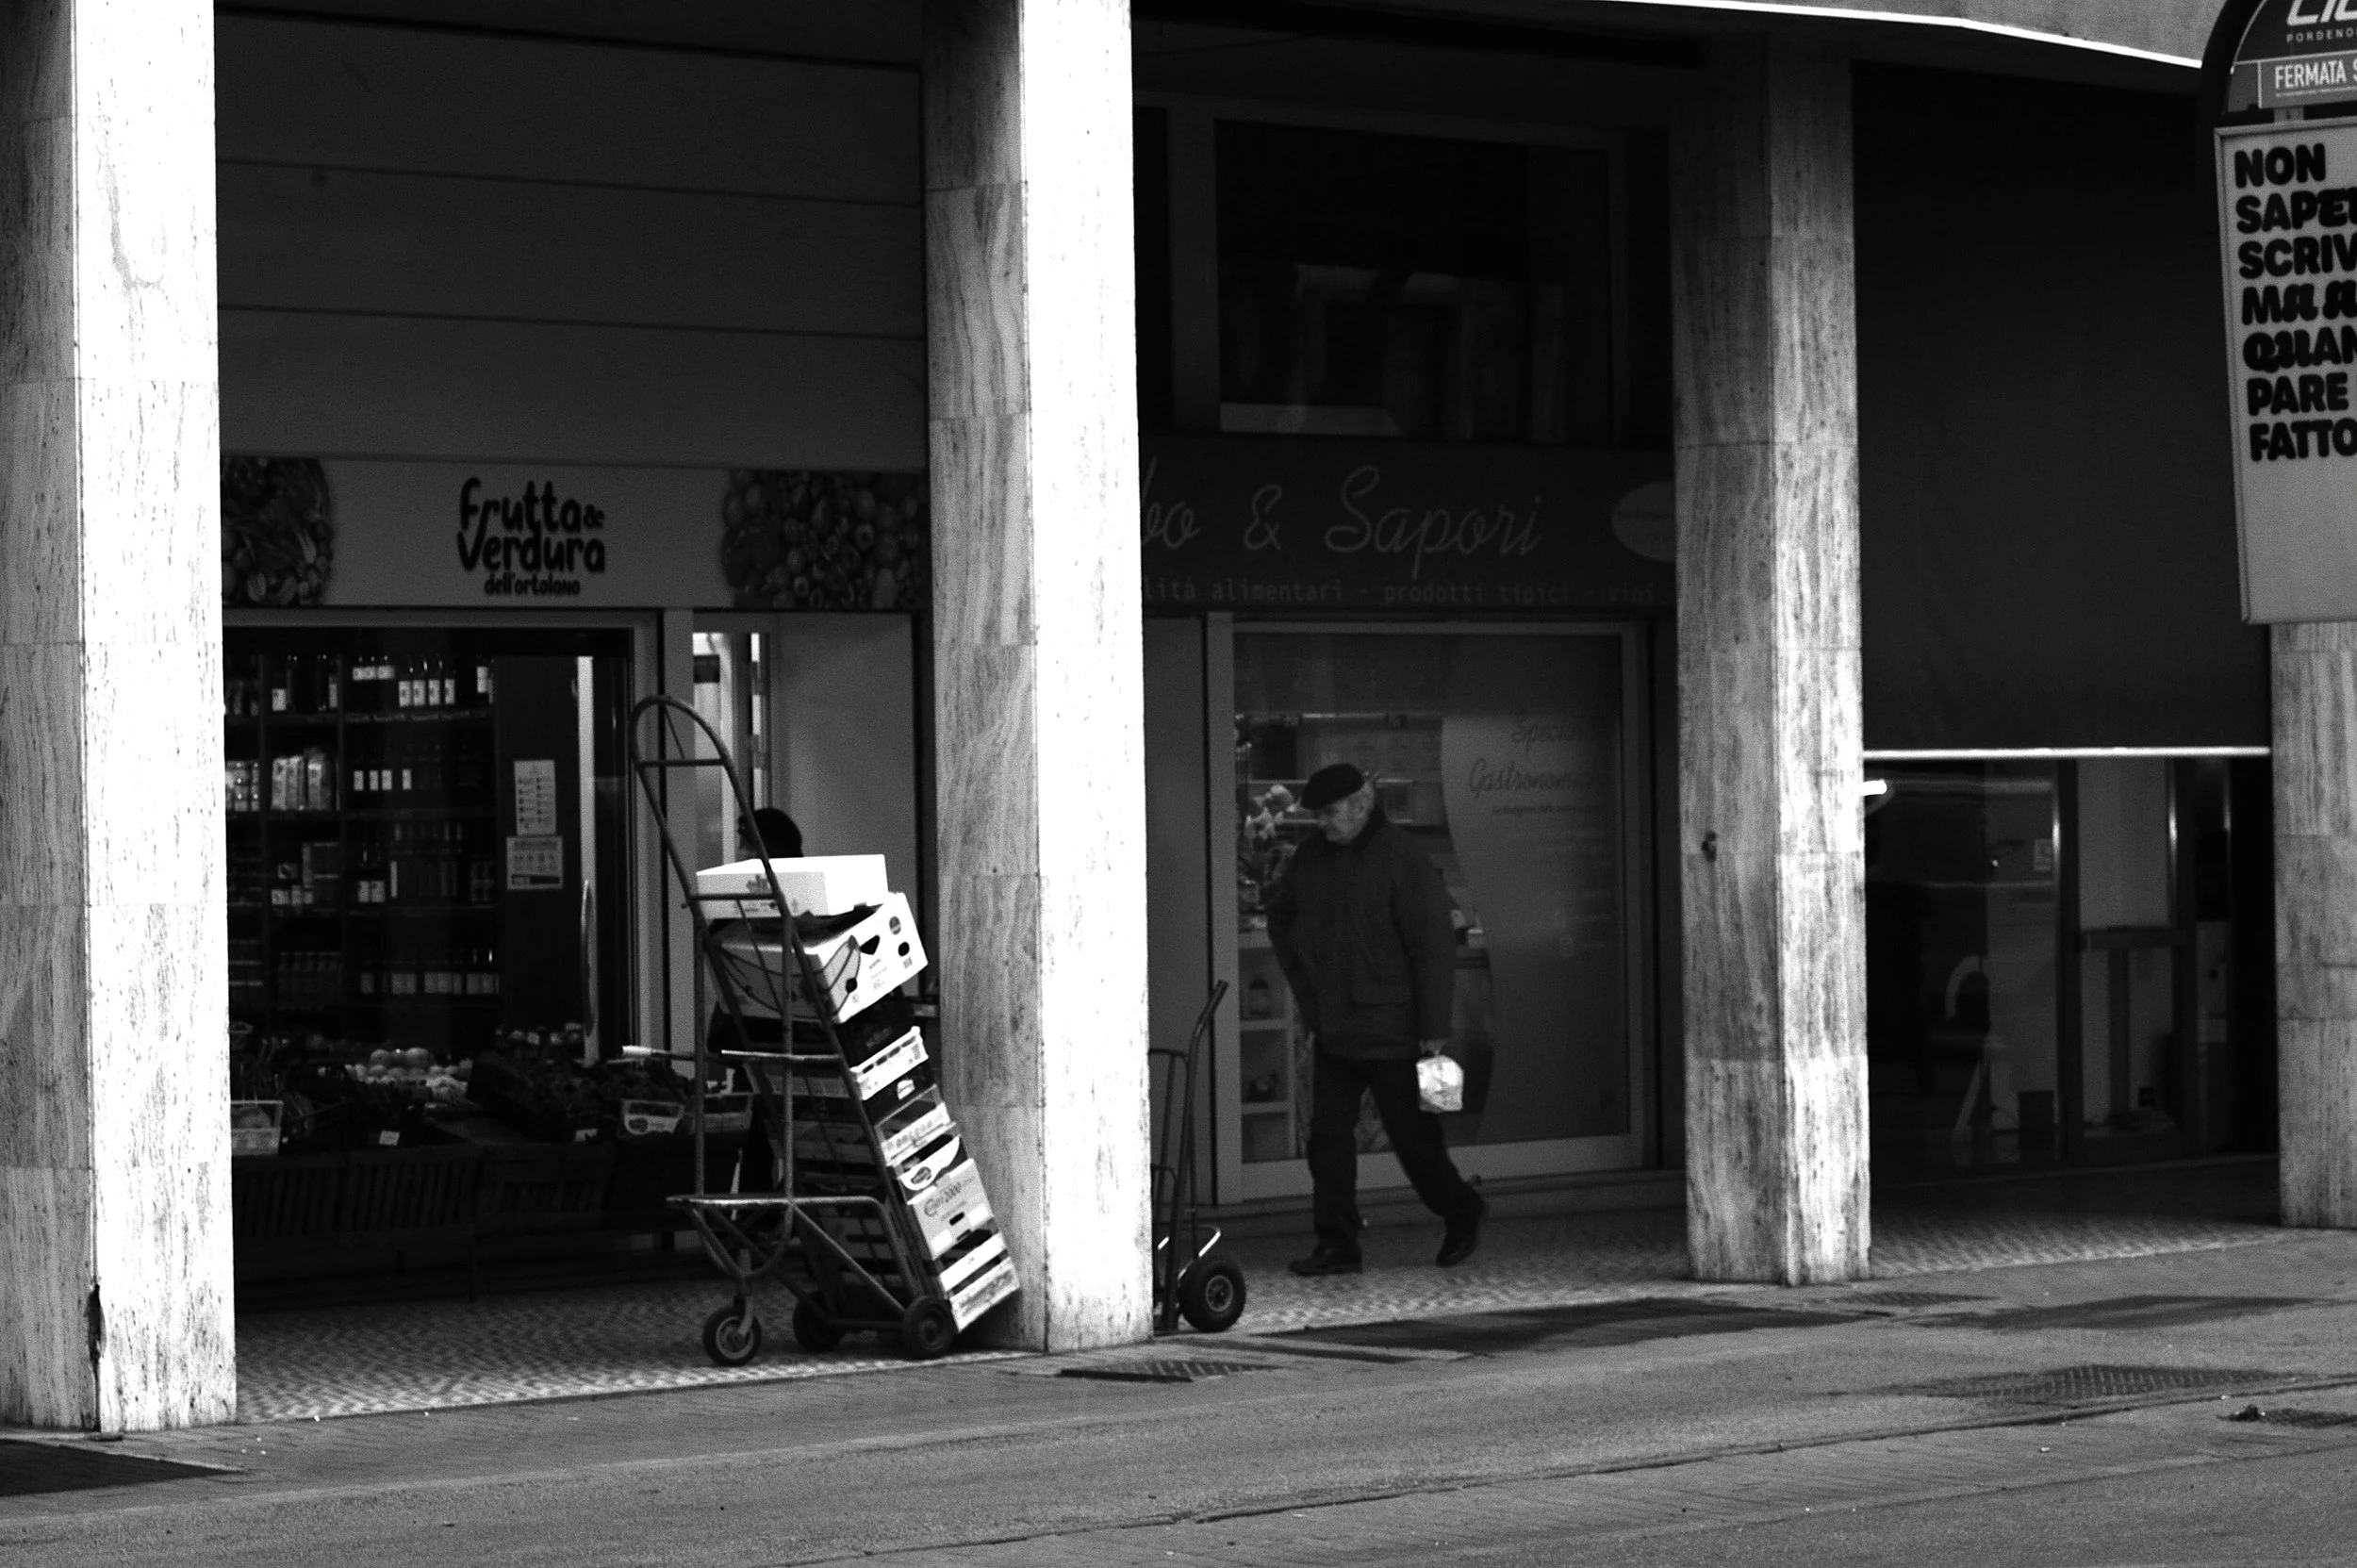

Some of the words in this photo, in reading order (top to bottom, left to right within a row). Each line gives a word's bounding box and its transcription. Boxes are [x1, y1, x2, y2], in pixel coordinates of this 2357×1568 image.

[2285, 27, 2357, 43] PORDENO
[2274, 59, 2347, 90] FERMATA
[2234, 143, 2326, 189] NON
[2235, 187, 2357, 234] SAPE
[2248, 372, 2349, 416] PARE
[2250, 418, 2357, 461] FATTO
[584, 503, 604, 528] &
[1243, 484, 1283, 551] &
[1324, 464, 1542, 580] Sapori
[1211, 576, 1343, 602] alimentari
[1383, 580, 1483, 606] prodotti
[1497, 580, 1570, 605] tipici
